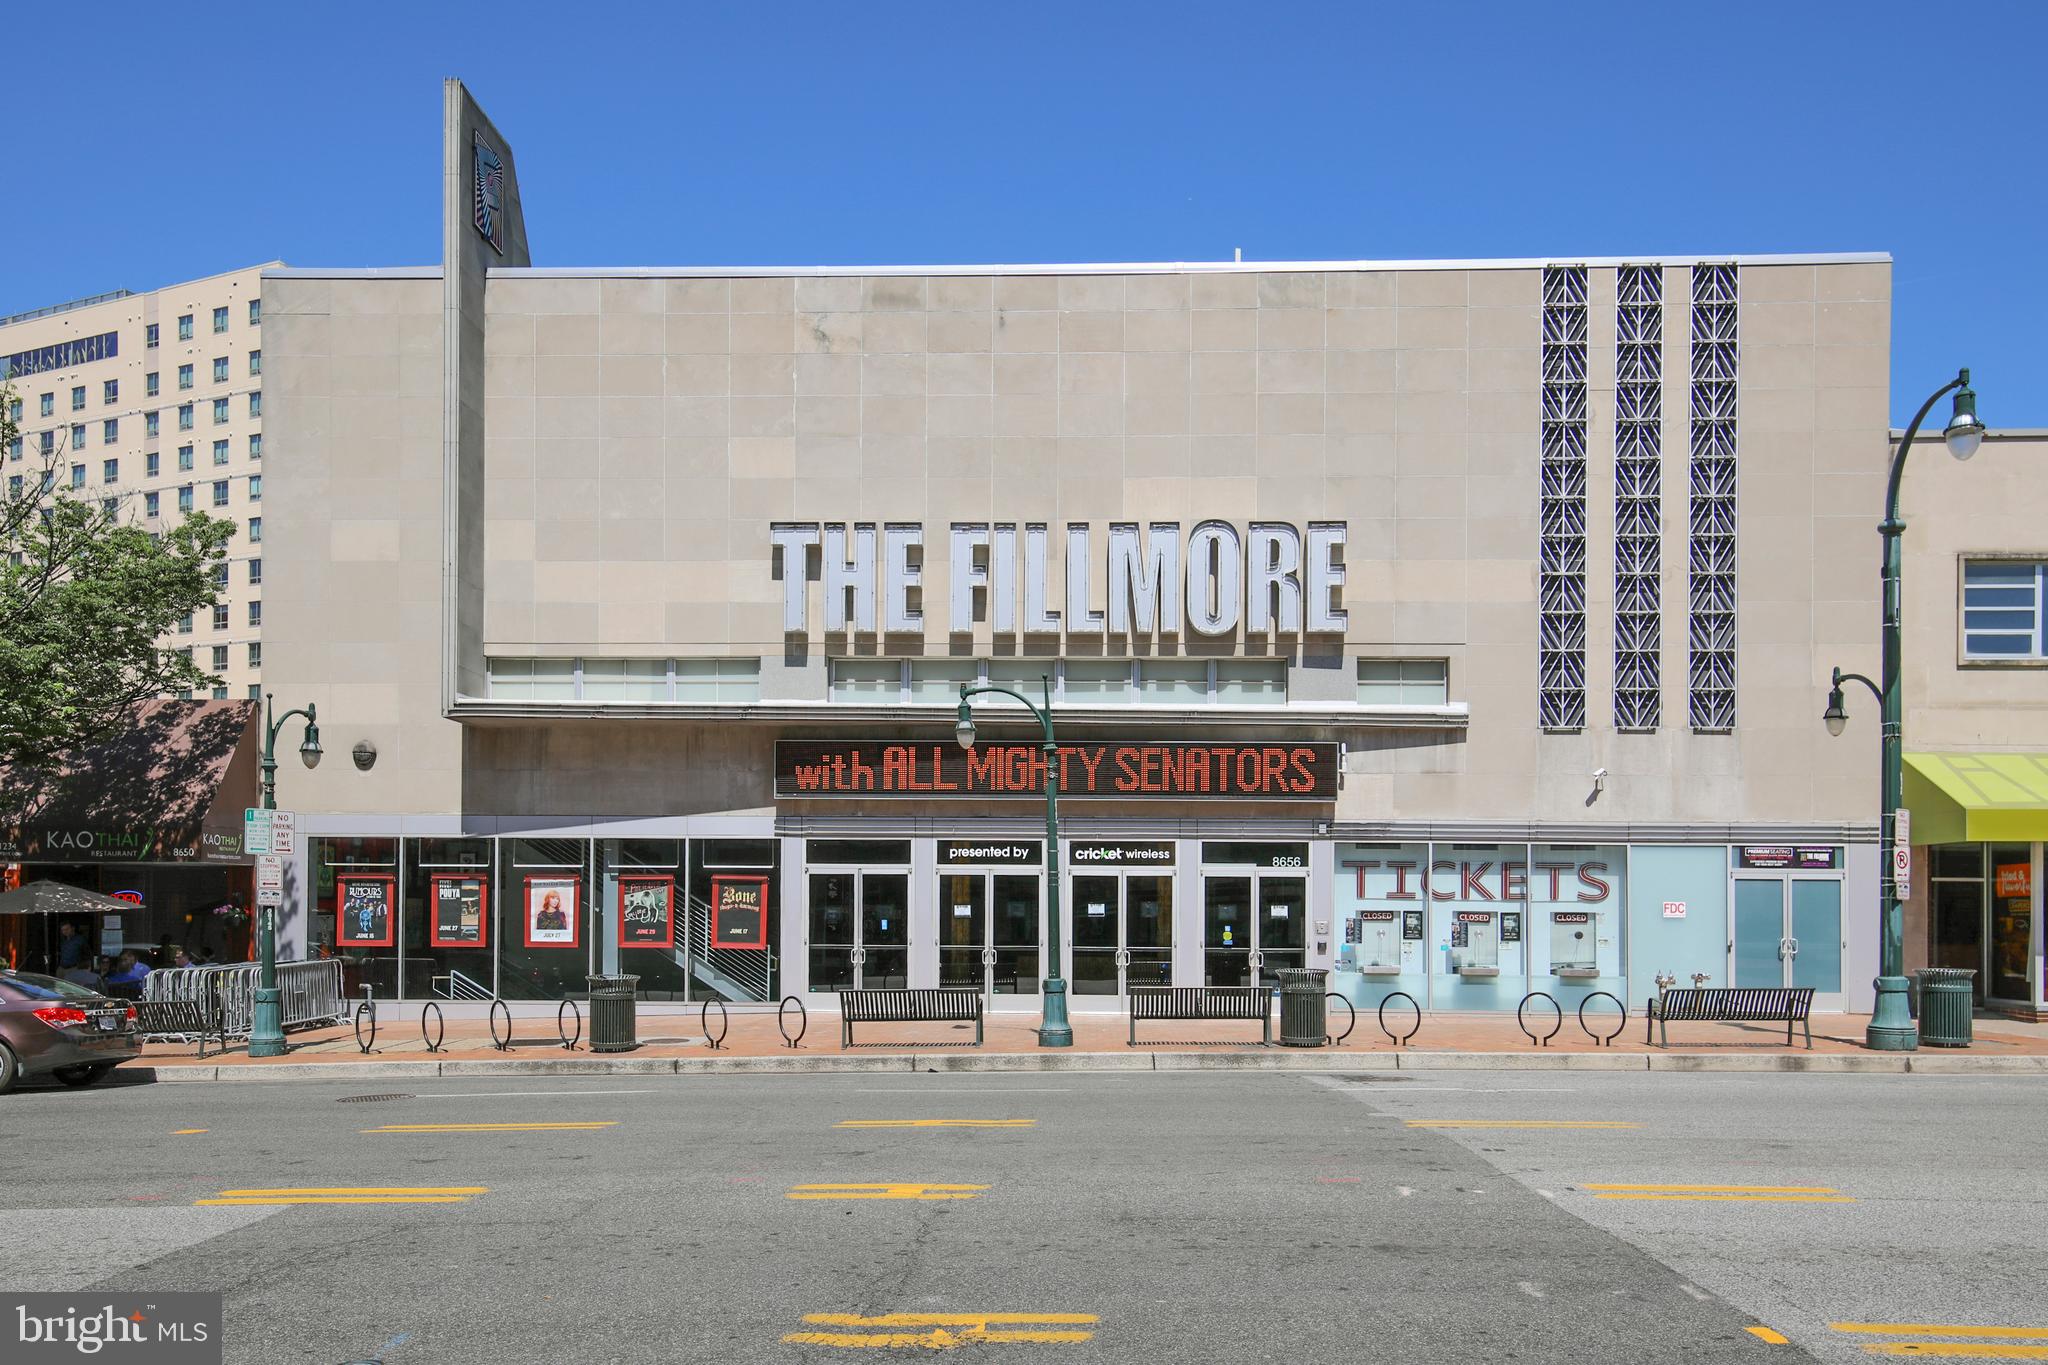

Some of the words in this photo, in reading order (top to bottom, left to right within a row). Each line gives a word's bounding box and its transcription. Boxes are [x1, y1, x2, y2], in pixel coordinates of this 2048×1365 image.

[770, 522, 924, 632] THE
[950, 520, 1348, 636] FILLMORE
[795, 751, 874, 790] with
[883, 746, 957, 790] ALL
[967, 747, 1106, 791] MIGHTY
[1115, 747, 1316, 792] SENATORS
[173, 848, 195, 857] 8650
[949, 847, 1011, 860] presented
[1013, 846, 1029, 860] by
[1075, 848, 1121, 860] cricket
[1125, 848, 1170, 859] wireless
[1272, 856, 1301, 867] 8656
[1342, 860, 1609, 901] TICKETS
[350, 887, 382, 897] RUMOURS
[440, 889, 460, 897] POUYA
[723, 886, 756, 903] Bone
[1663, 903, 1685, 913] FDC
[1362, 912, 1392, 920] CLOSED
[1459, 914, 1489, 922] CLOSED
[1556, 914, 1587, 922] CLOSED
